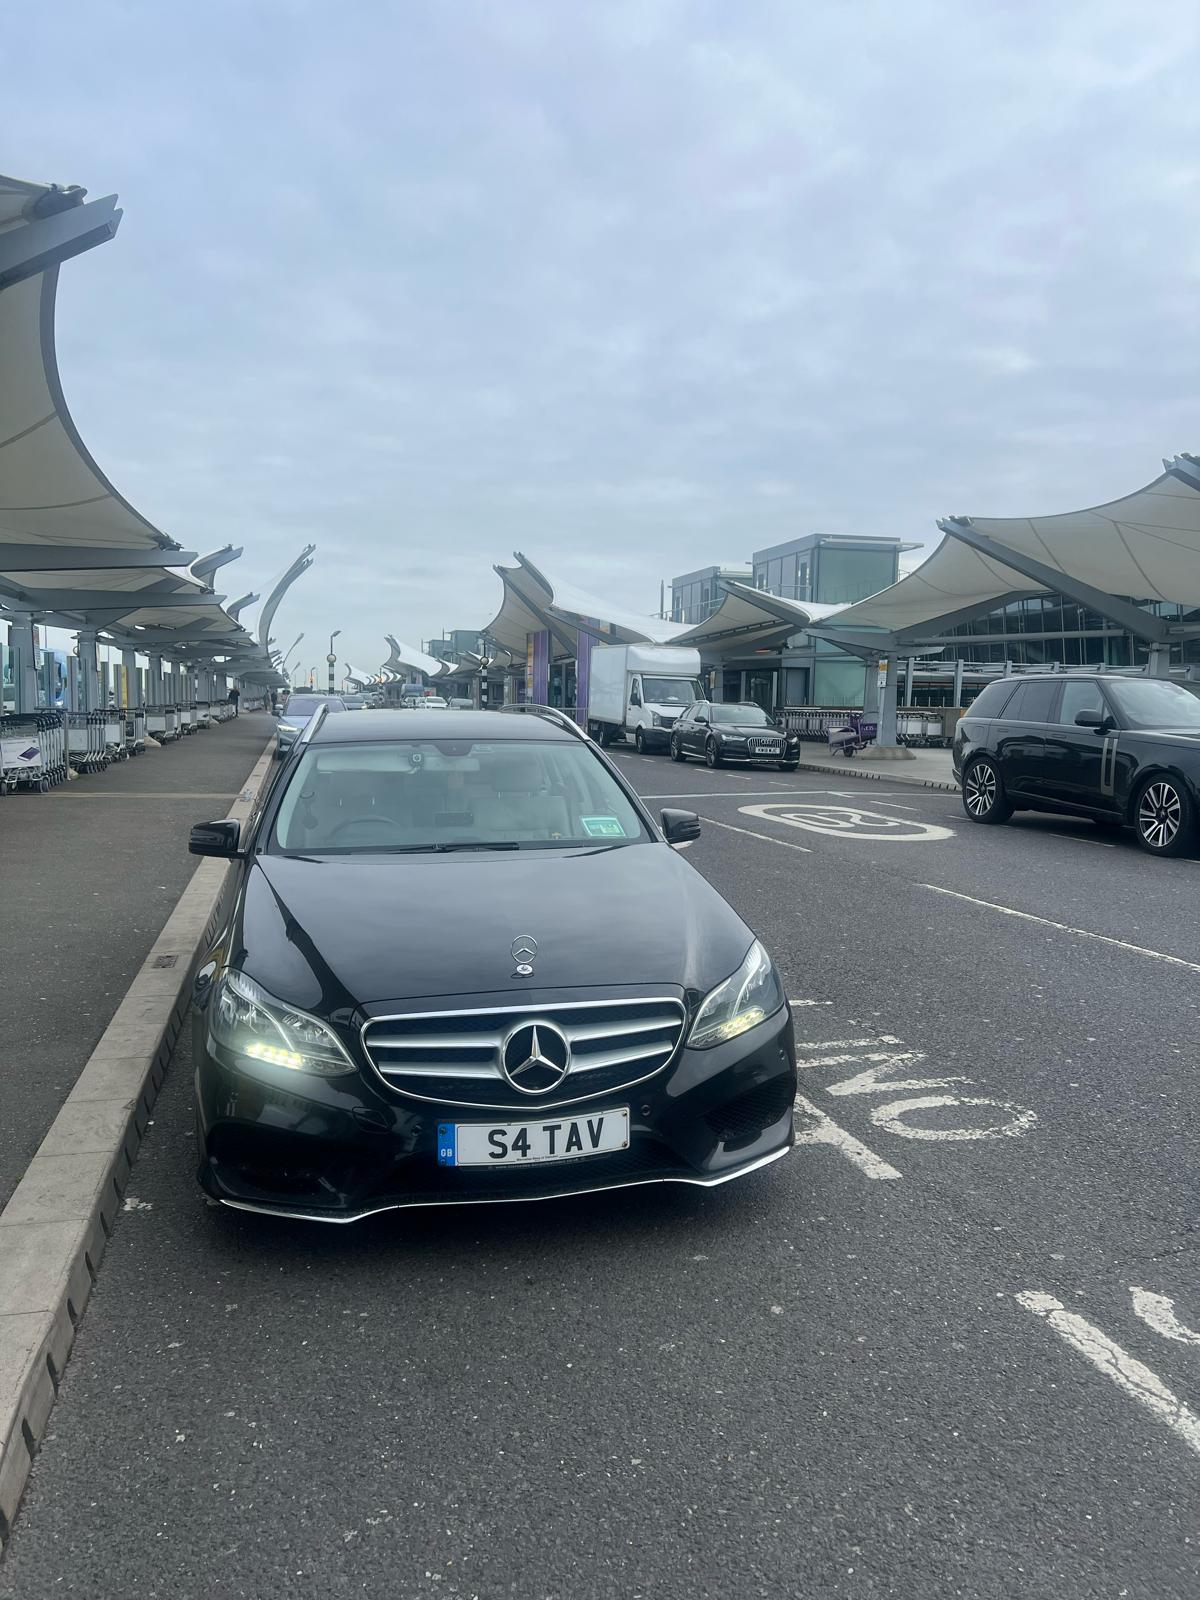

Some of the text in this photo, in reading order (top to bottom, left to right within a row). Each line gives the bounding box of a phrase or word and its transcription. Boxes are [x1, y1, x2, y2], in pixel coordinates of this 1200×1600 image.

[488, 1117, 604, 1159] S4 TAV
[440, 1148, 453, 1158] GB
